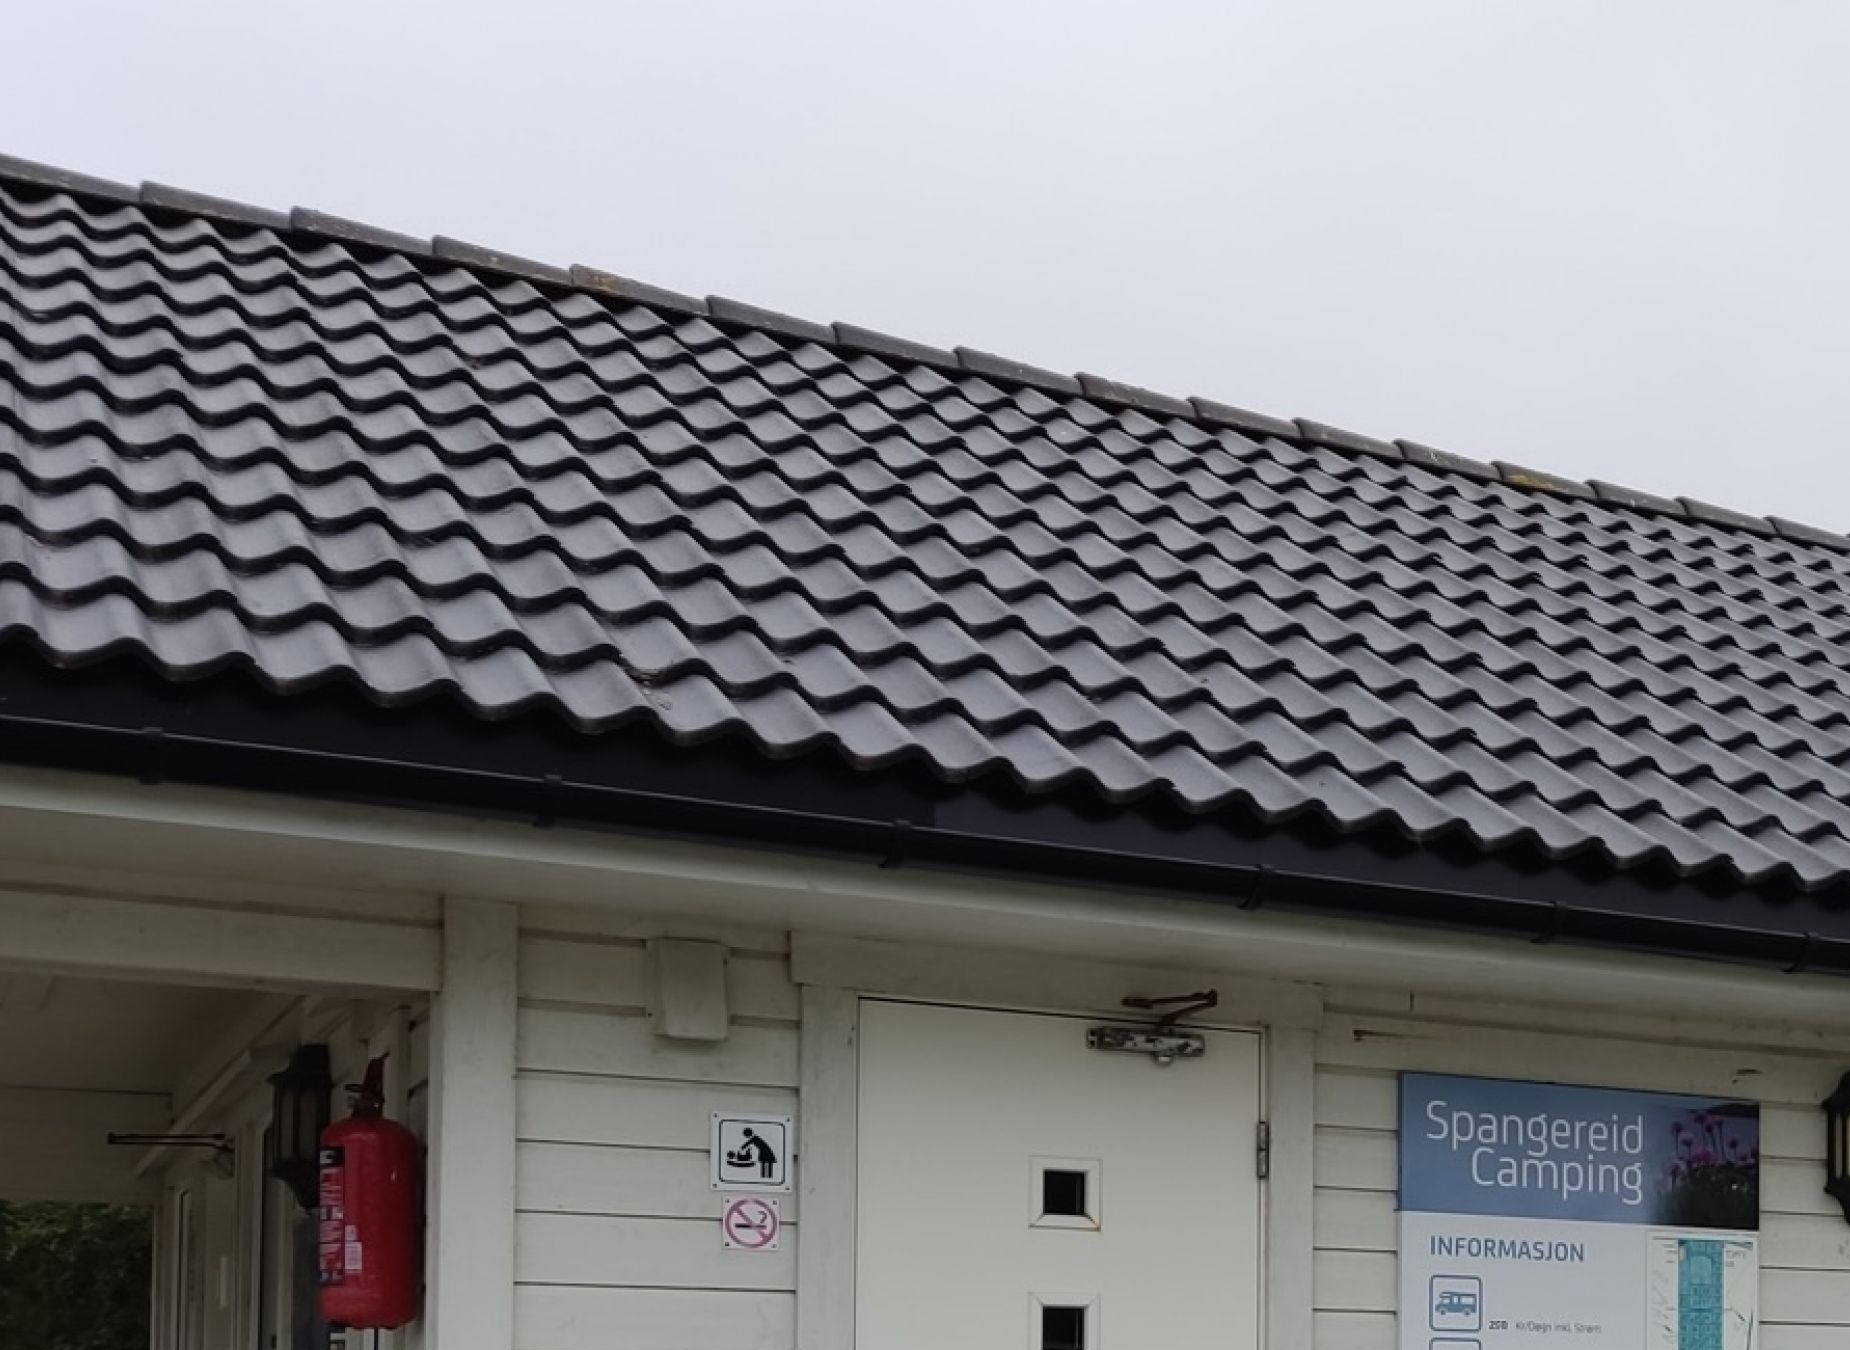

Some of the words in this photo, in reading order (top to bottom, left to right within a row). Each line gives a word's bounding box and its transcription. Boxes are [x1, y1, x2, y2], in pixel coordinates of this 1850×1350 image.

[1426, 1100, 1644, 1157] Spangereid
[1472, 1147, 1643, 1205] Camping
[1430, 1235, 1584, 1262] INFORMASJON
